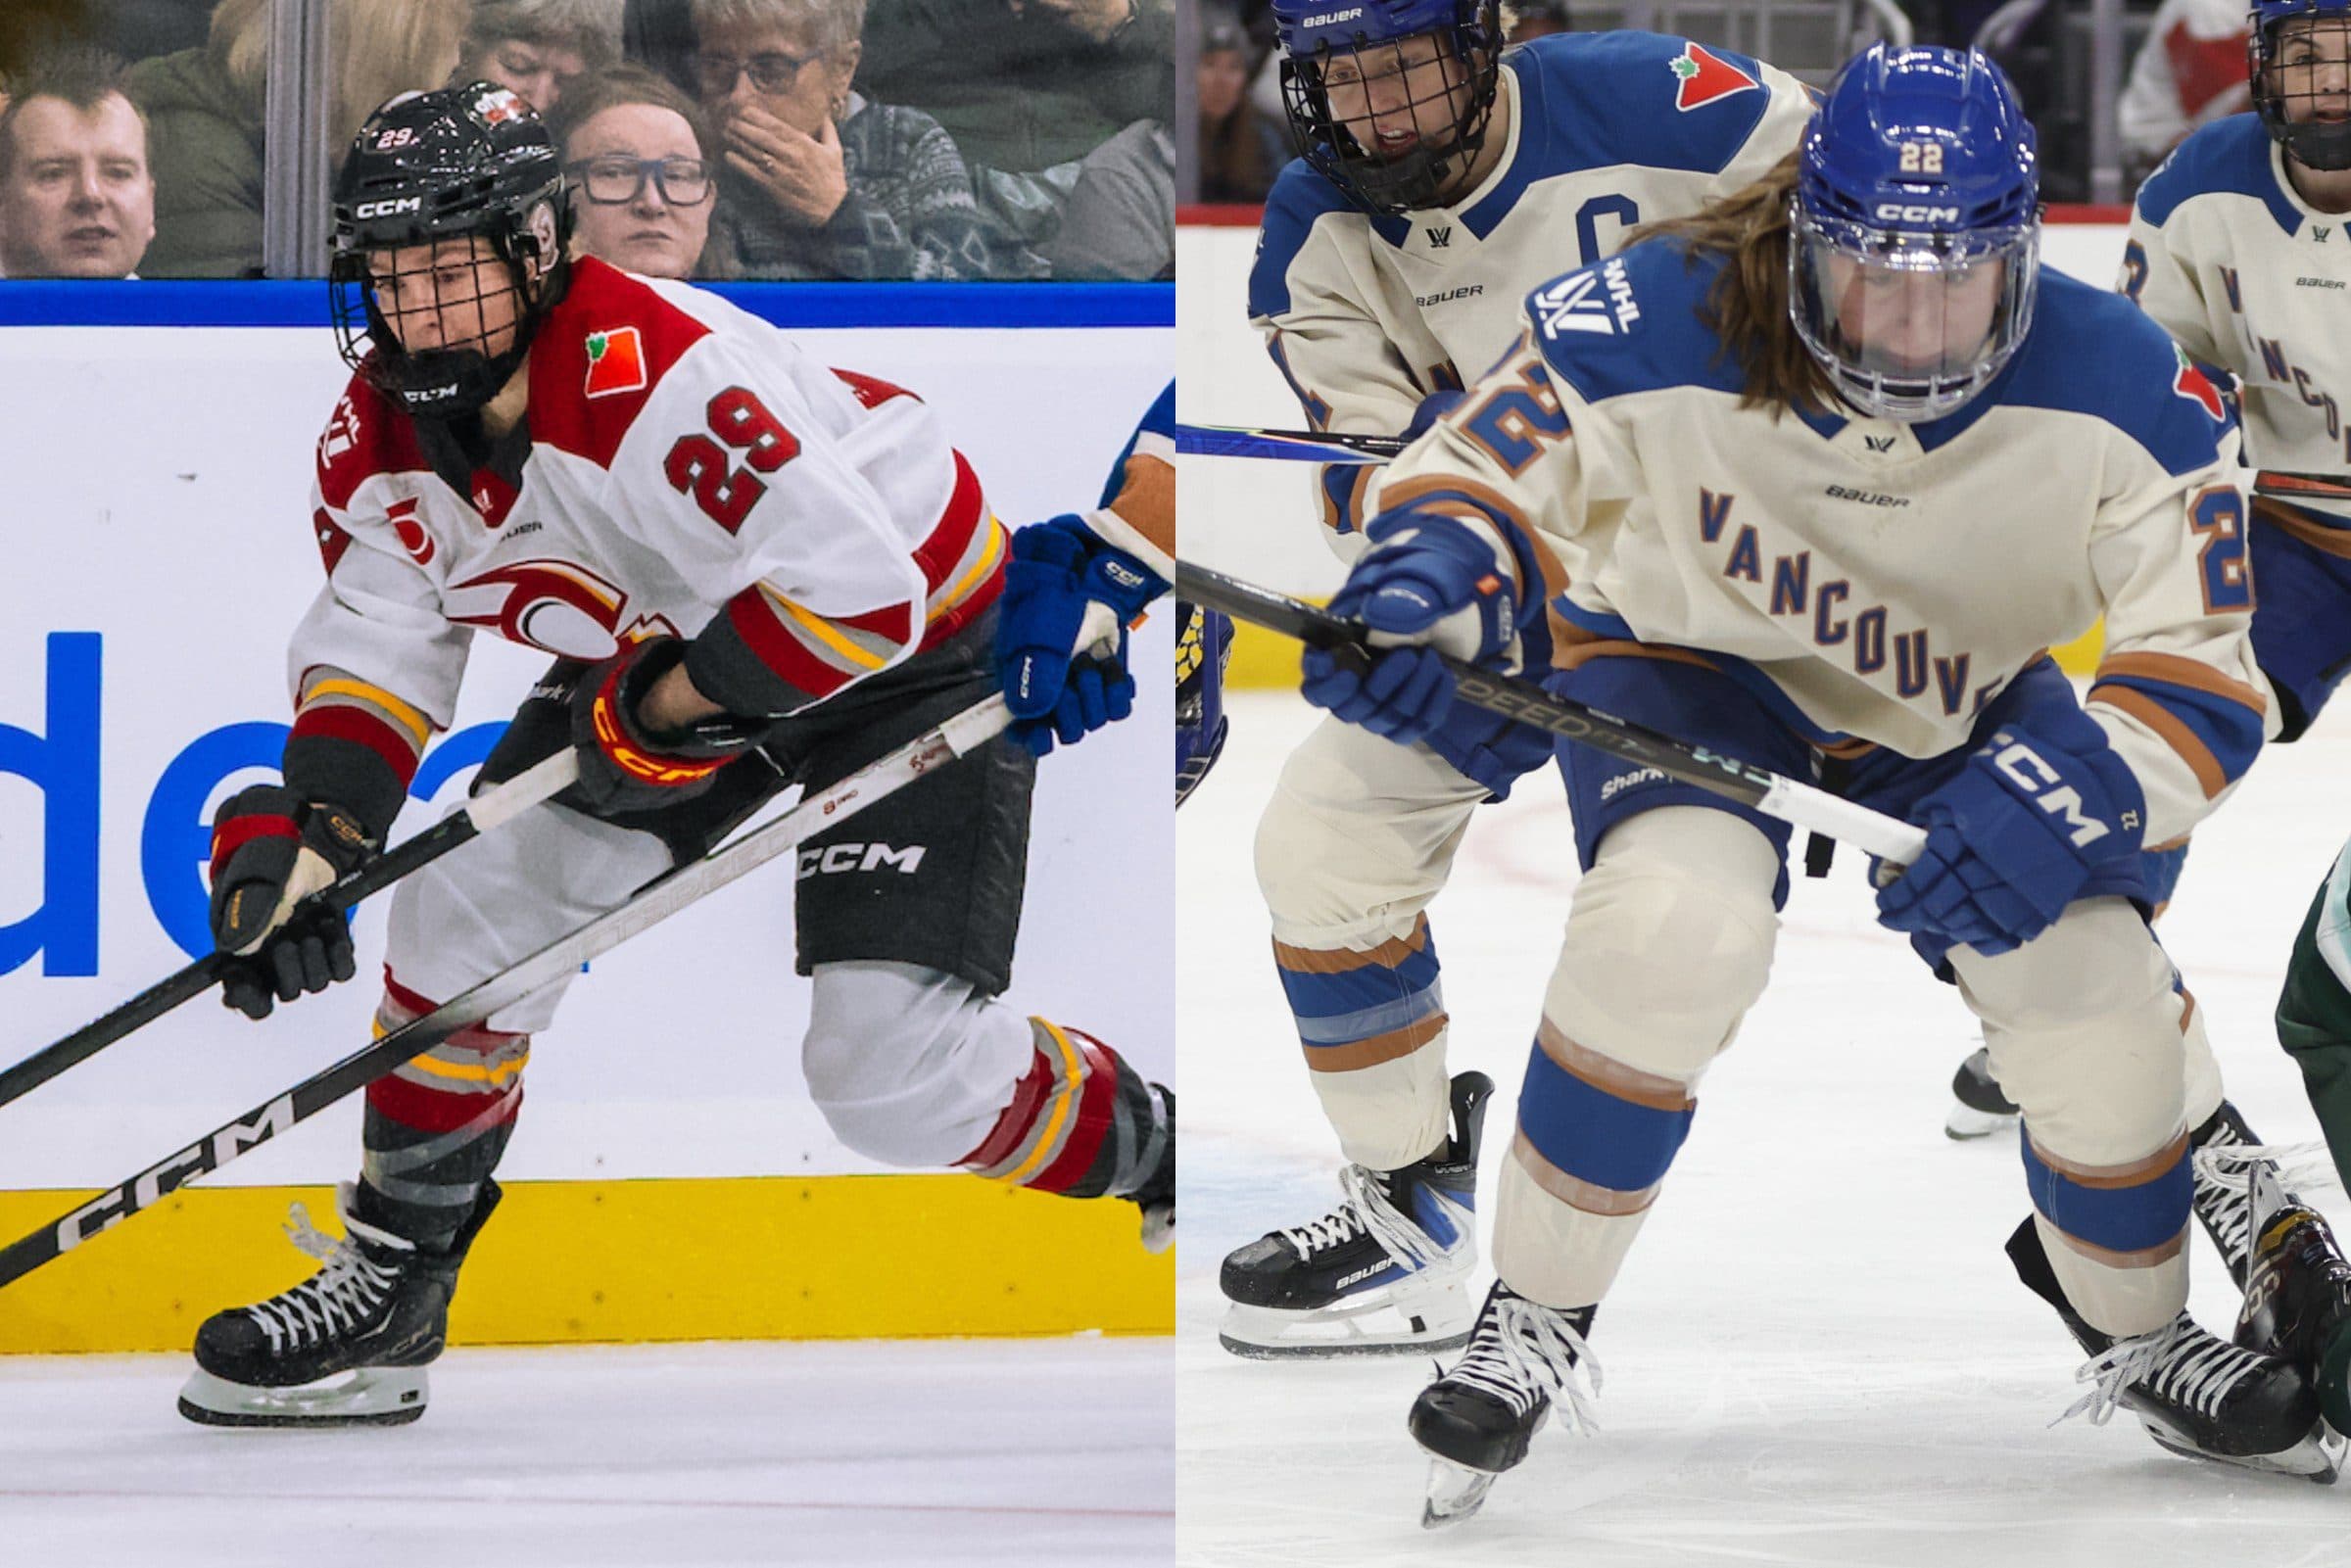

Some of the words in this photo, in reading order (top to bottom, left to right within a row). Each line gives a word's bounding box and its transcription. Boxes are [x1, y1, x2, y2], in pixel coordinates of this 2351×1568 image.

[376, 127, 413, 148] 29
[1899, 142, 1943, 174] 22
[357, 197, 421, 219] CCM
[1877, 204, 1959, 224] CCM
[1575, 193, 1640, 267] C
[664, 385, 801, 537] 29
[1973, 732, 2110, 848] CM
[797, 842, 928, 881] CCM
[57, 1091, 295, 1253] CCM
